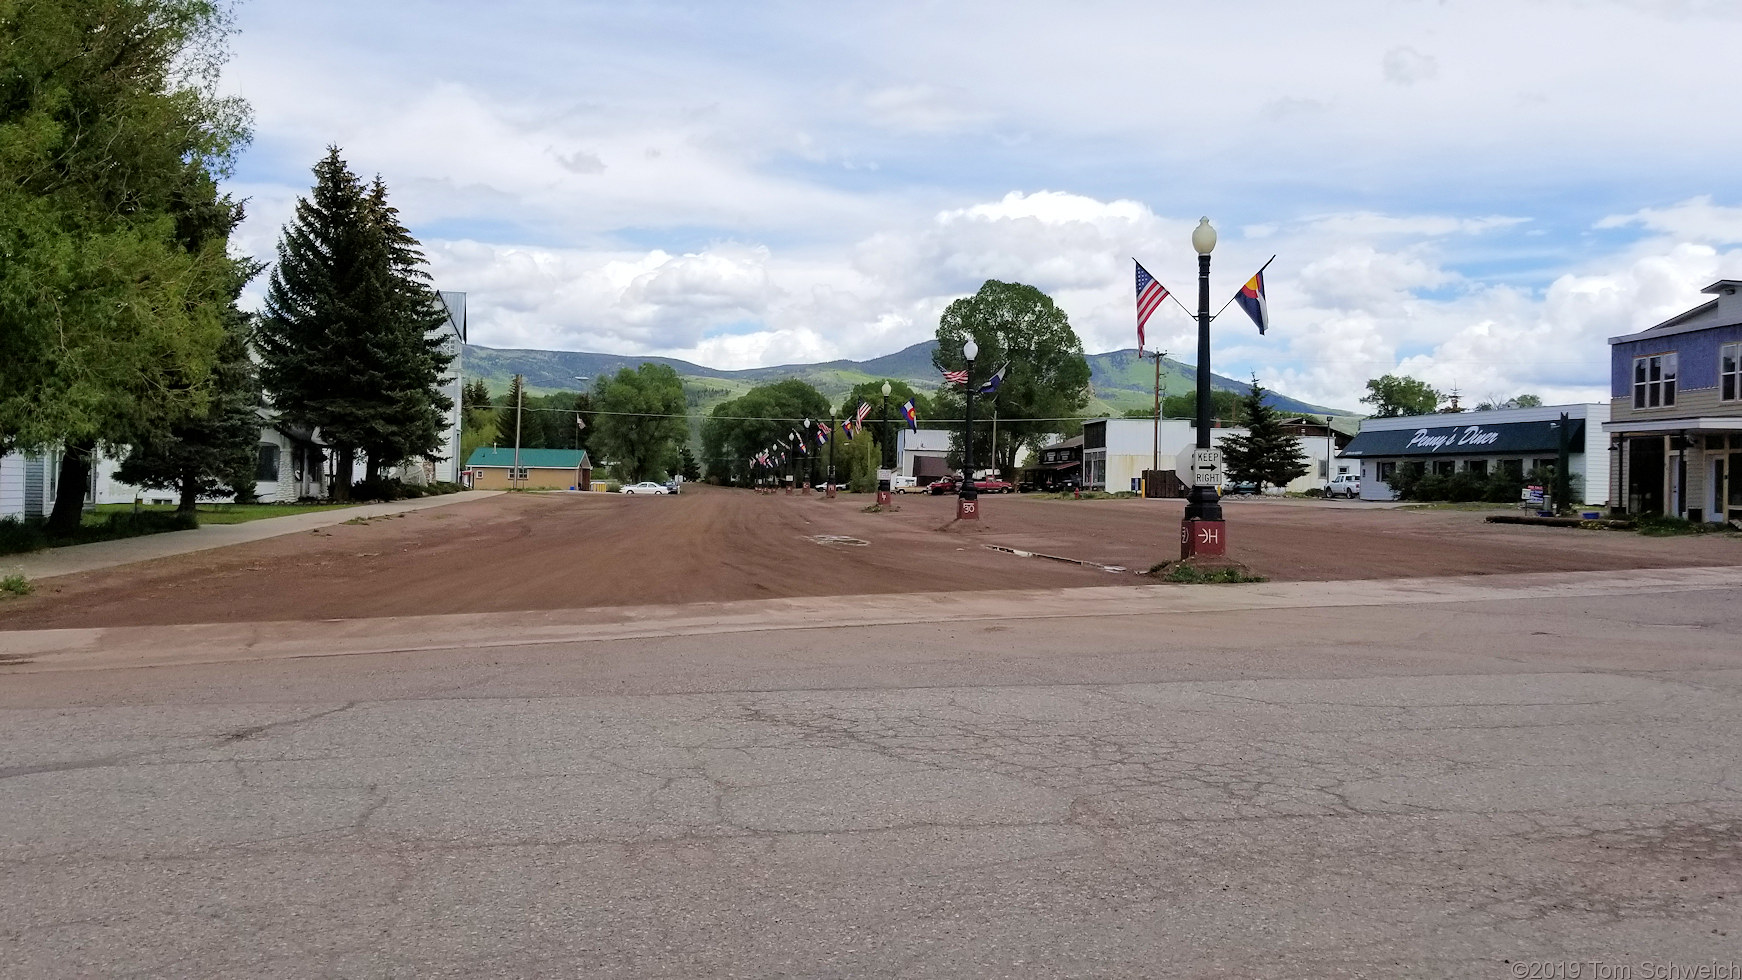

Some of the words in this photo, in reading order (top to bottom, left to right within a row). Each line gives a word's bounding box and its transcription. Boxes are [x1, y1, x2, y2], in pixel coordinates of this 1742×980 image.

[1406, 427, 1458, 452] Penny's
[1458, 426, 1498, 445] Diner
[1197, 453, 1219, 462] KEEP
[1196, 473, 1220, 482] RIGHT
